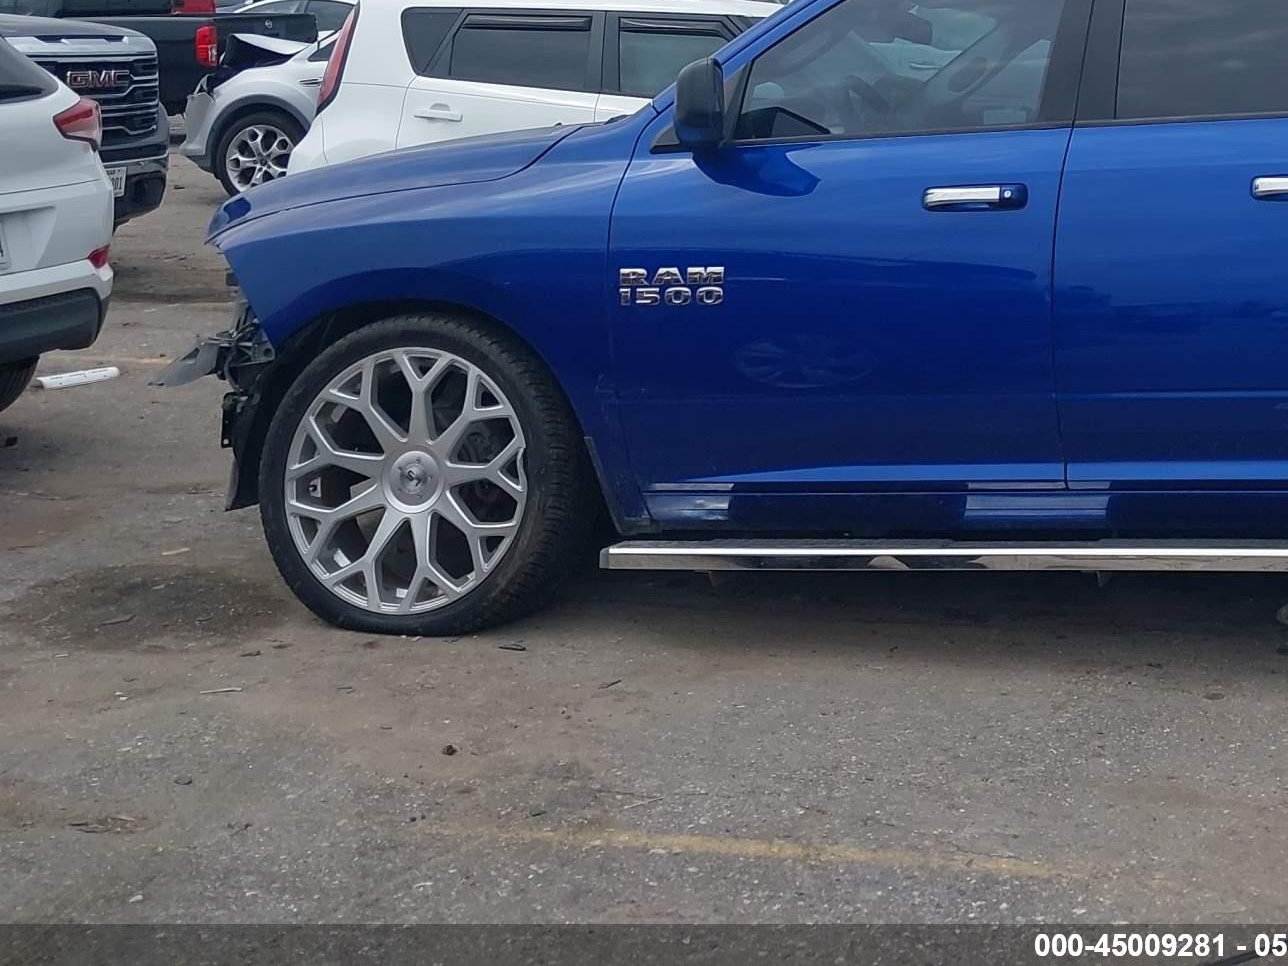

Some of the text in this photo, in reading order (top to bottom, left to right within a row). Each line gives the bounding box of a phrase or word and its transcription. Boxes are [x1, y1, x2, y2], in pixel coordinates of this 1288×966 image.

[66, 69, 130, 89] GMC
[618, 265, 726, 286] RAM
[618, 286, 724, 306] 1500
